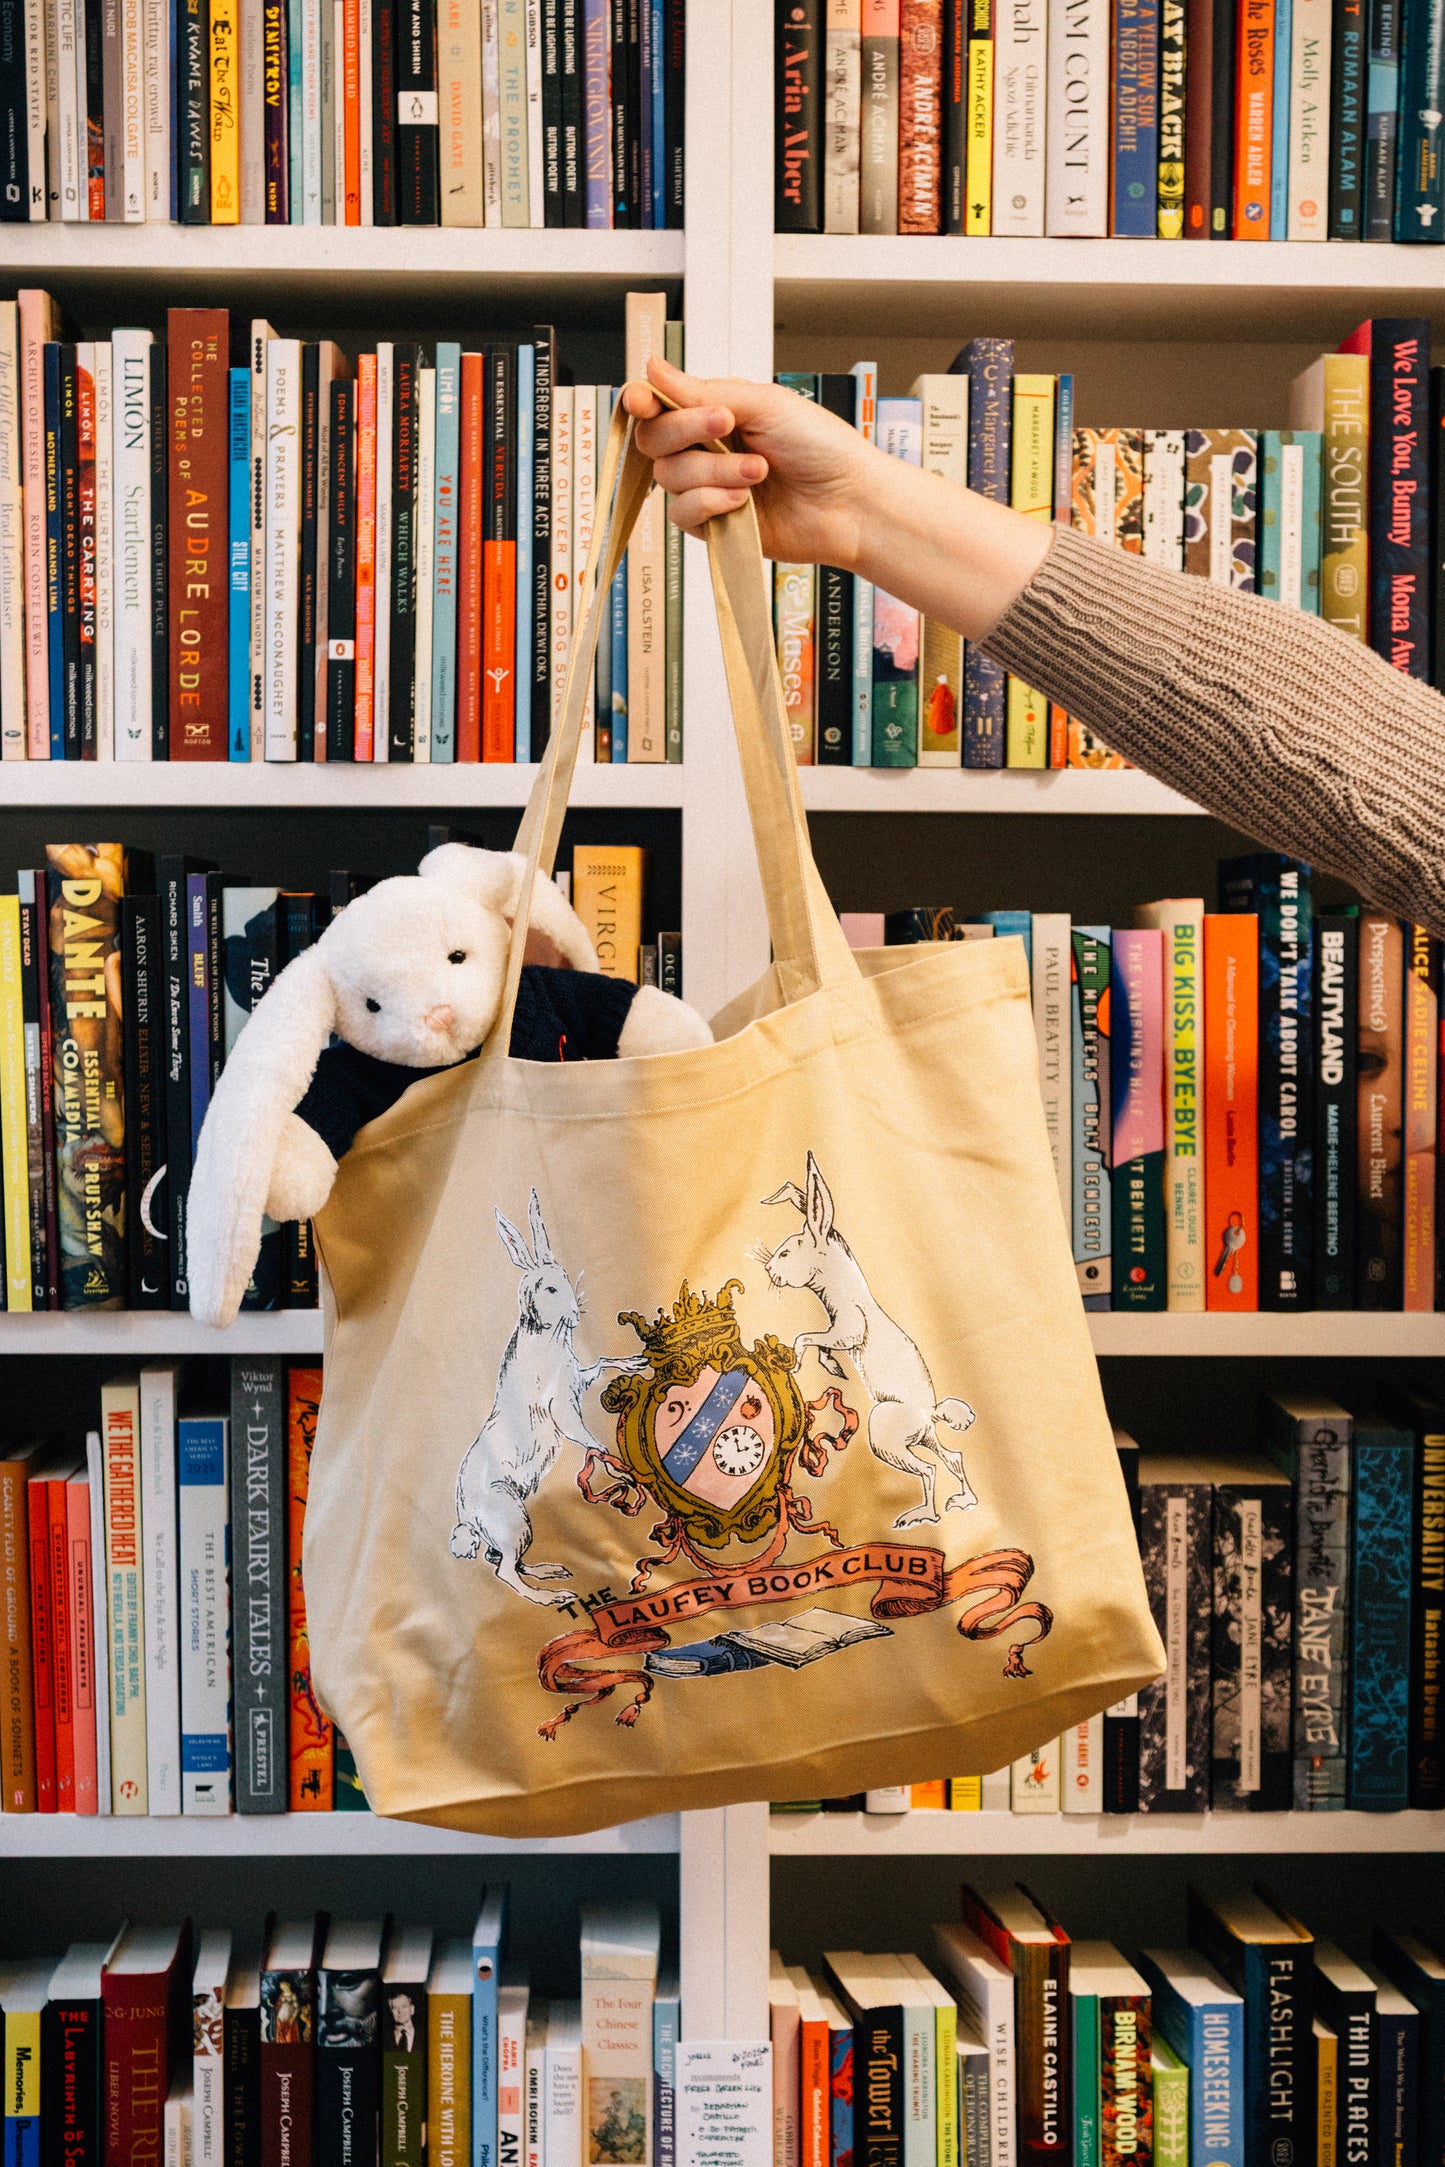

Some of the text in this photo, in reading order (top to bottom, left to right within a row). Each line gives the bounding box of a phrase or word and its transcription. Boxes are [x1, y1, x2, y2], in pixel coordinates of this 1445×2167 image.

[126, 1, 138, 158] ROB MACAISA COLGATE
[146, 1, 162, 134] brittny ray crowell
[188, 22, 203, 161] KWAME DAWES
[212, 18, 233, 52] Eat
[214, 57, 230, 83] The
[784, 43, 810, 105] Aria
[450, 82, 462, 168] DAVID GATE
[505, 67, 520, 203] THE PROPHET
[587, 18, 605, 180] NIKKI GIOVANNI
[616, 105, 625, 191] RAIN MOUNTAIN PRESS
[871, 51, 886, 163] ANDRÉ ACIMAN
[914, 75, 936, 214] ANDRÉ ACIMAN
[975, 49, 985, 138] KATHY ACKER
[1065, 54, 1090, 173] COUNT
[1161, 51, 1183, 158] BLACK
[1248, 93, 1264, 185] WARREN ADLER
[1301, 38, 1320, 163] Molly Aitken
[1341, 31, 1359, 190] RUMAAN ALAM
[566, 127, 576, 191] BUTTON POETRY
[783, 124, 810, 204] Aber
[191, 340, 202, 437] COLLECTED
[206, 335, 218, 361] THE
[64, 376, 75, 613] LIMÓN BRIGHT DEAD THINGS
[81, 392, 94, 638] LIMÓN THE CARRYING
[125, 358, 148, 609] LIMÓN Startlement
[438, 367, 456, 595] LIMÓN YOU ARE HERE
[535, 340, 550, 682] A TINDERBOX IN THREE ACTS CYNTHIA DEWI OKA
[557, 413, 568, 553] MARY OLIVER
[1331, 383, 1362, 542] THE SOUTH
[1387, 340, 1417, 631] We Love You, Bunny Mona
[175, 397, 209, 706] POEMS OF AUDRE LORDE
[232, 541, 248, 591] STILL CITY
[270, 369, 296, 717] POEMS & PRAYERS MATTHEW McCONAUGHEY
[783, 611, 811, 706] Muses
[827, 573, 840, 680] ANDERSON
[62, 879, 105, 1019] DANTE
[135, 915, 149, 1023] AARON SHURIN
[1173, 924, 1195, 970] BIG
[22, 908, 37, 1124] STAY DEAD NATALIE SHAPERO
[1046, 947, 1060, 1083] PAUL BEATTY
[1280, 872, 1298, 1140] WE DON'T TALK ABOUT CAROL
[1369, 923, 1389, 1198] Perspective(s) Laurent Binet
[63, 1038, 80, 1143] COMMEDIA
[84, 1051, 99, 1130] ESSENTIAL
[105, 1081, 115, 1099] THE
[1175, 1048, 1195, 1157] BYE-BYE
[1321, 932, 1344, 1255] BEAUTYLAND MARIE-HELENE BERTINO
[85, 1162, 103, 1257] PRUE SHAW
[107, 1411, 136, 1566] WE THE GATHERED HEAT
[1422, 1435, 1444, 1590] UNIVERSALITY
[246, 1425, 270, 1675] DARK FAIRY TALES
[557, 1553, 926, 1628] THE LAUFEY BOOK CLUB
[1299, 1587, 1340, 1671] JANE
[255, 1731, 267, 1786] PRESTEL
[1302, 1674, 1339, 1746] EYRE
[58, 2012, 88, 2022] THE
[1043, 1980, 1057, 2145] ELAINE CASTILLO
[1270, 1960, 1293, 2122] FLASHLIGHT
[15, 2047, 31, 2113] Memories,
[64, 2028, 84, 2124] LABYRINTH
[338, 2067, 353, 2164] JOSEPH CAMPBELL
[394, 2066, 408, 2152] JOSEPH CAMPBELL
[440, 2011, 454, 2145] THE HEROINE WITH
[868, 2030, 897, 2131] the Tower
[1115, 2012, 1136, 2154] BIRNAM WOOD
[1202, 2014, 1230, 2147] HOMESEEKING
[1347, 2013, 1369, 2162] THIN PLACES
[64, 2131, 84, 2141] OF
